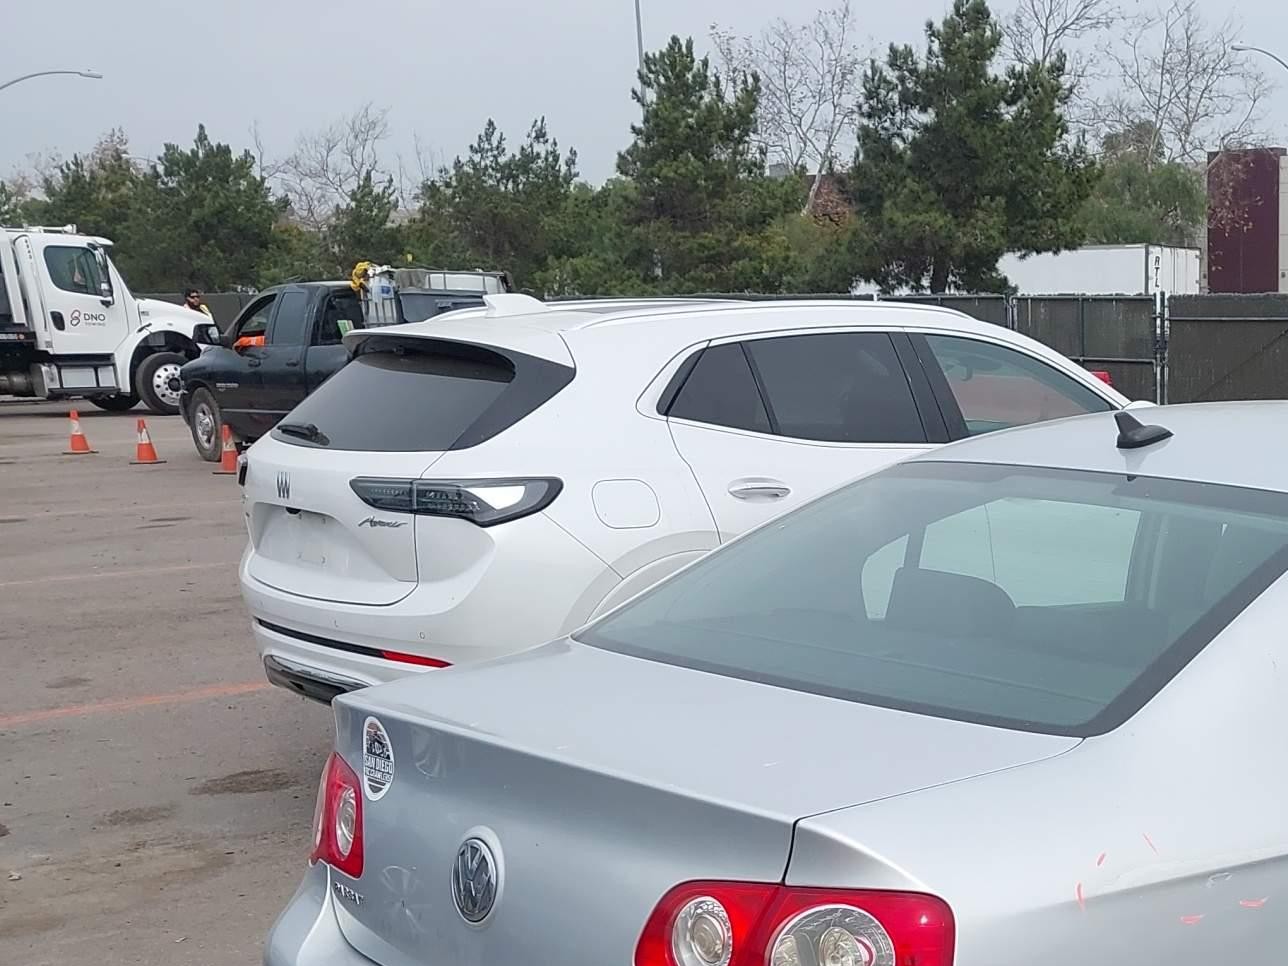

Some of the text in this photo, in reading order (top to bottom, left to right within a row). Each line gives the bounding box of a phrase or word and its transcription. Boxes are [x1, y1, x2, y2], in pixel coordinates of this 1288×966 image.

[83, 313, 106, 321] DNO
[365, 754, 393, 774] SAN DIEGO
